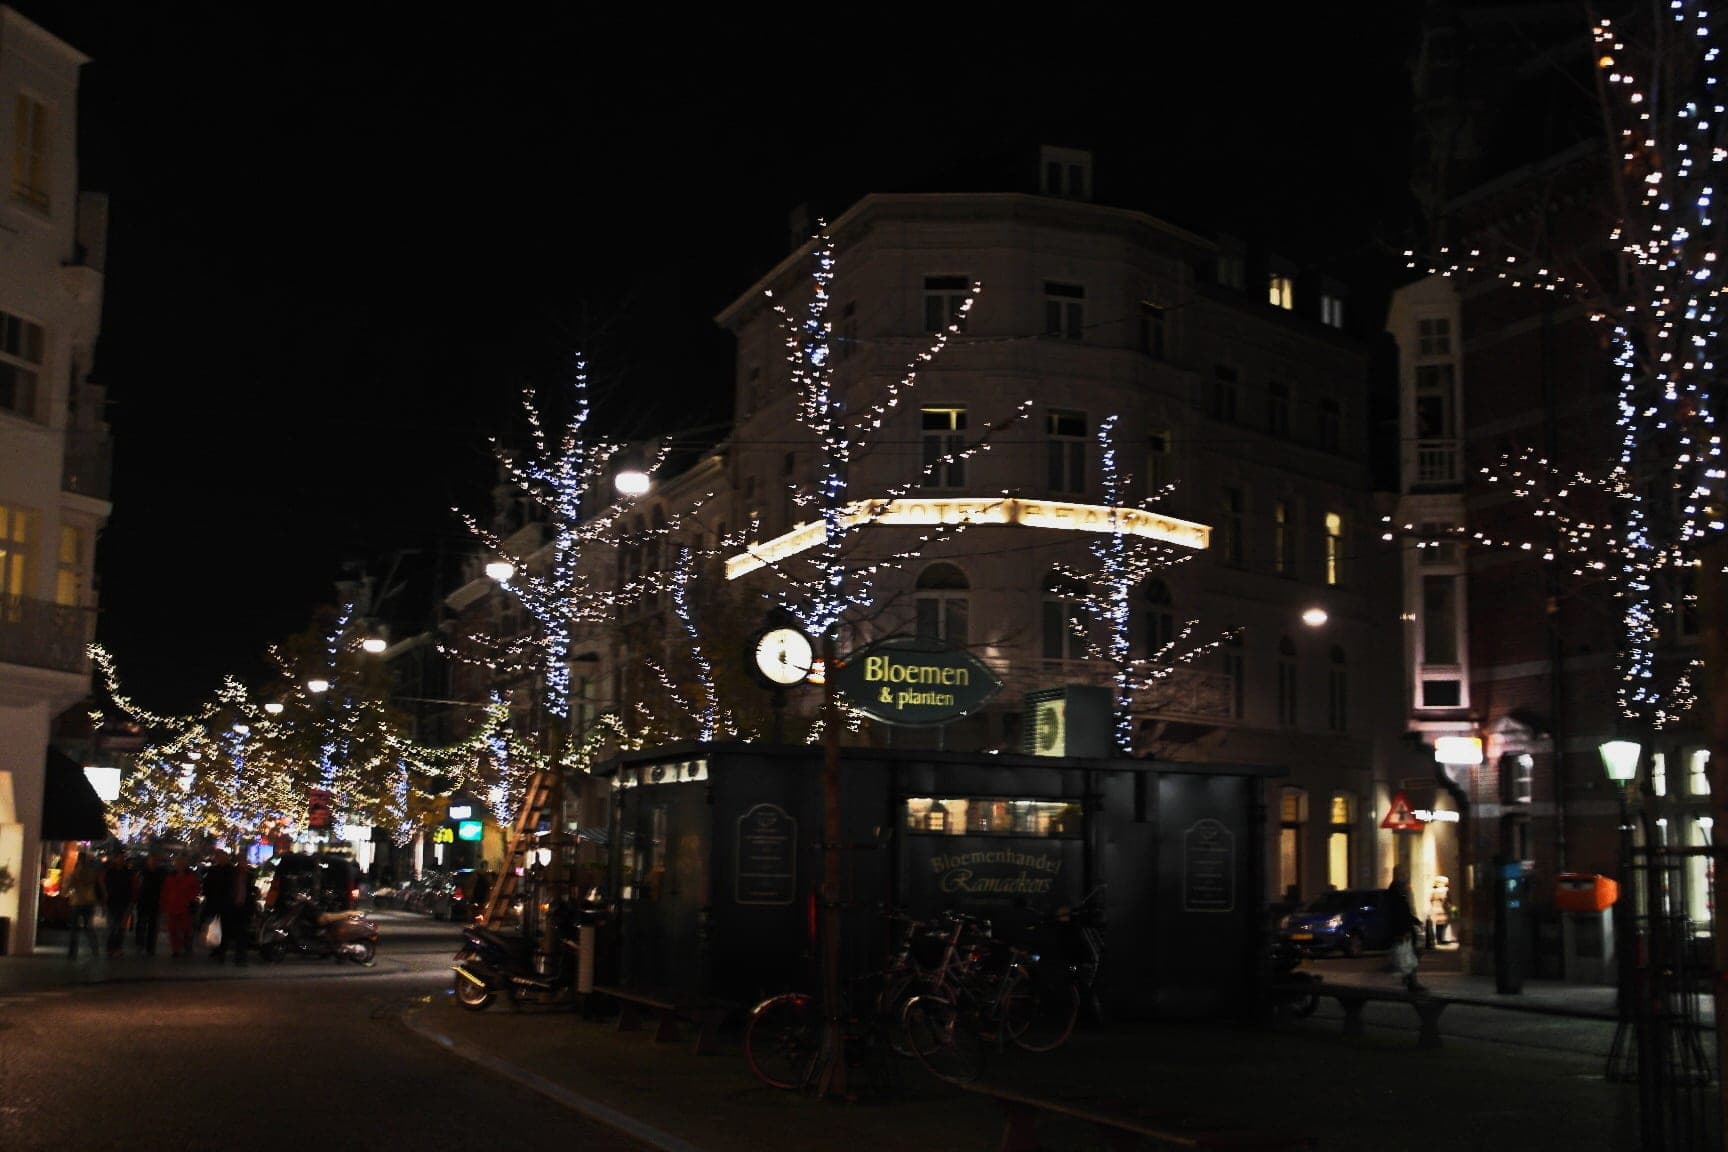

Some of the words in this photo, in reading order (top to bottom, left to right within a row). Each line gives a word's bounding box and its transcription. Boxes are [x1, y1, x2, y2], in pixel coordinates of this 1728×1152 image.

[864, 656, 970, 686] Bloemen
[879, 686, 894, 704] &
[897, 688, 954, 709] planten
[930, 847, 1063, 874] Bloemenhandel
